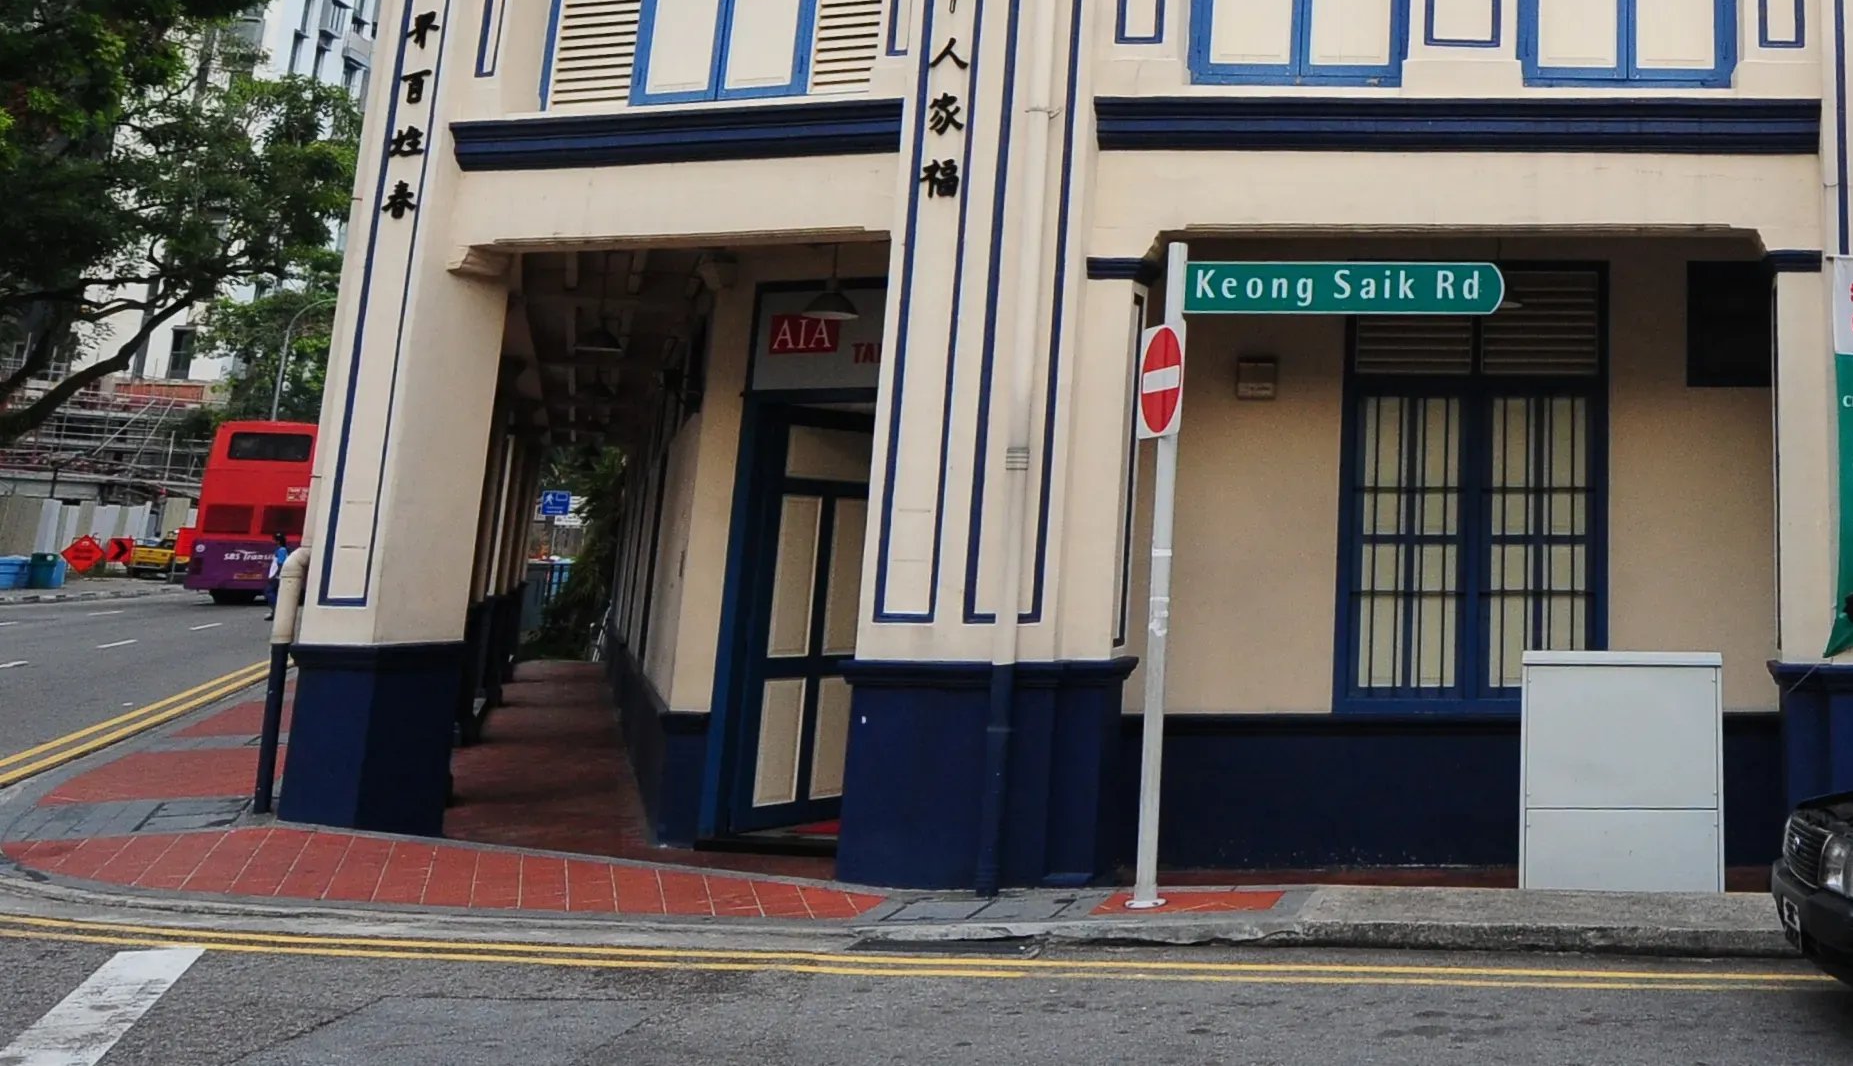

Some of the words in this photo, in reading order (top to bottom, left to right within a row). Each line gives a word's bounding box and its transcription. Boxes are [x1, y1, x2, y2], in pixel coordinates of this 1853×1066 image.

[1196, 270, 1315, 306] Keong
[1333, 269, 1416, 300] Saik
[1437, 270, 1481, 301] Rd
[771, 318, 832, 349] AIA
